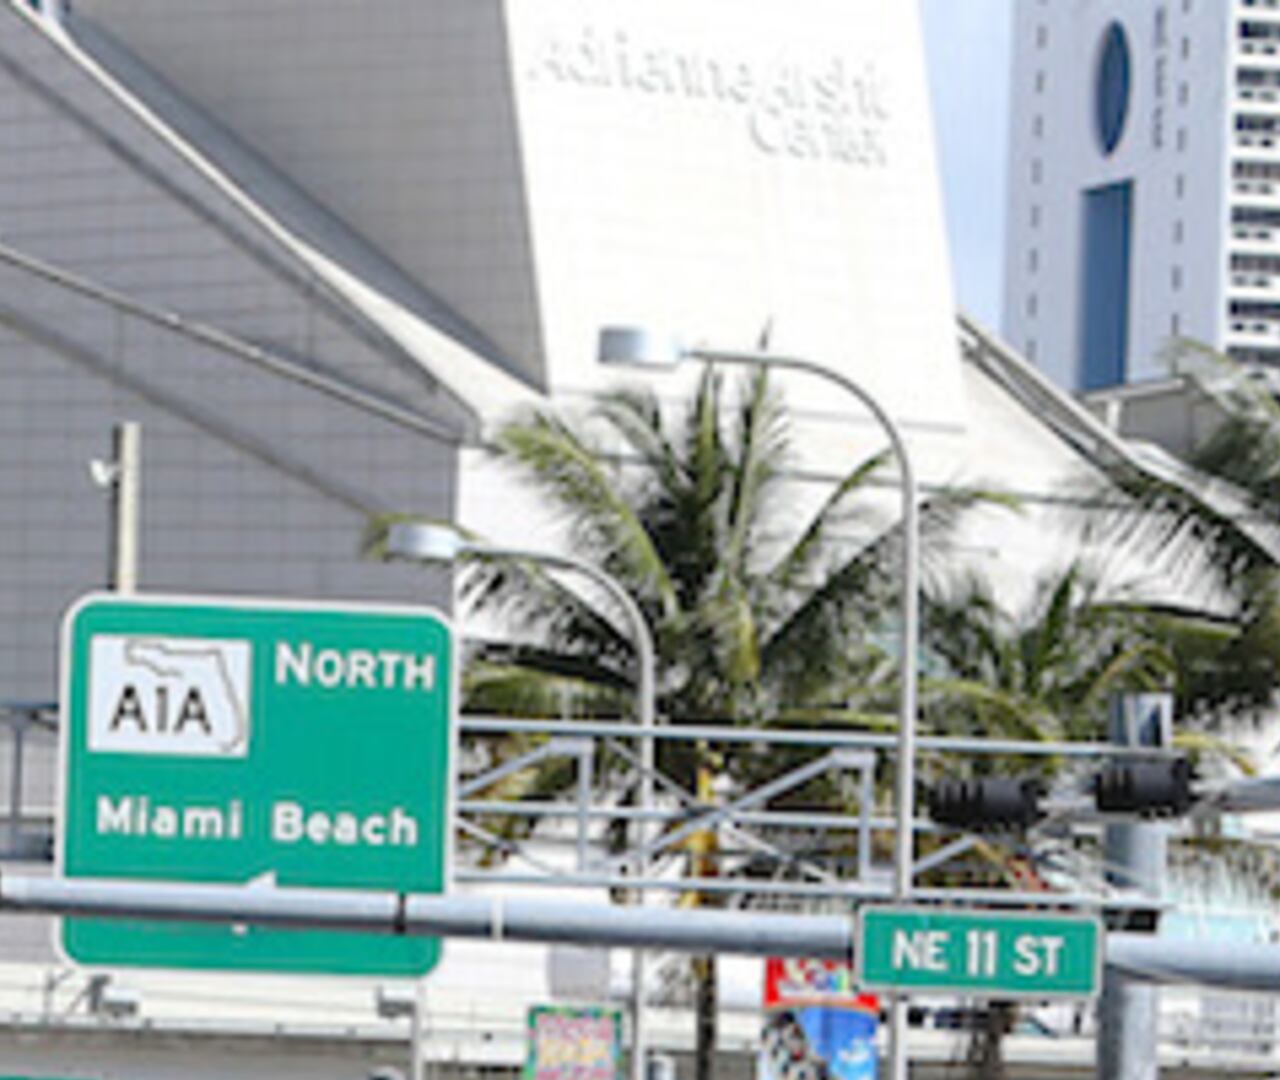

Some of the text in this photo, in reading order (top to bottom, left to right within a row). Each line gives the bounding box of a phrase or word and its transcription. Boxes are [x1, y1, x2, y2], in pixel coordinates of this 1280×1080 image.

[274, 642, 435, 690] NORTH
[108, 684, 213, 734] A1A
[96, 796, 418, 845] Miami Beach
[892, 930, 1065, 976] NE 11 ST
